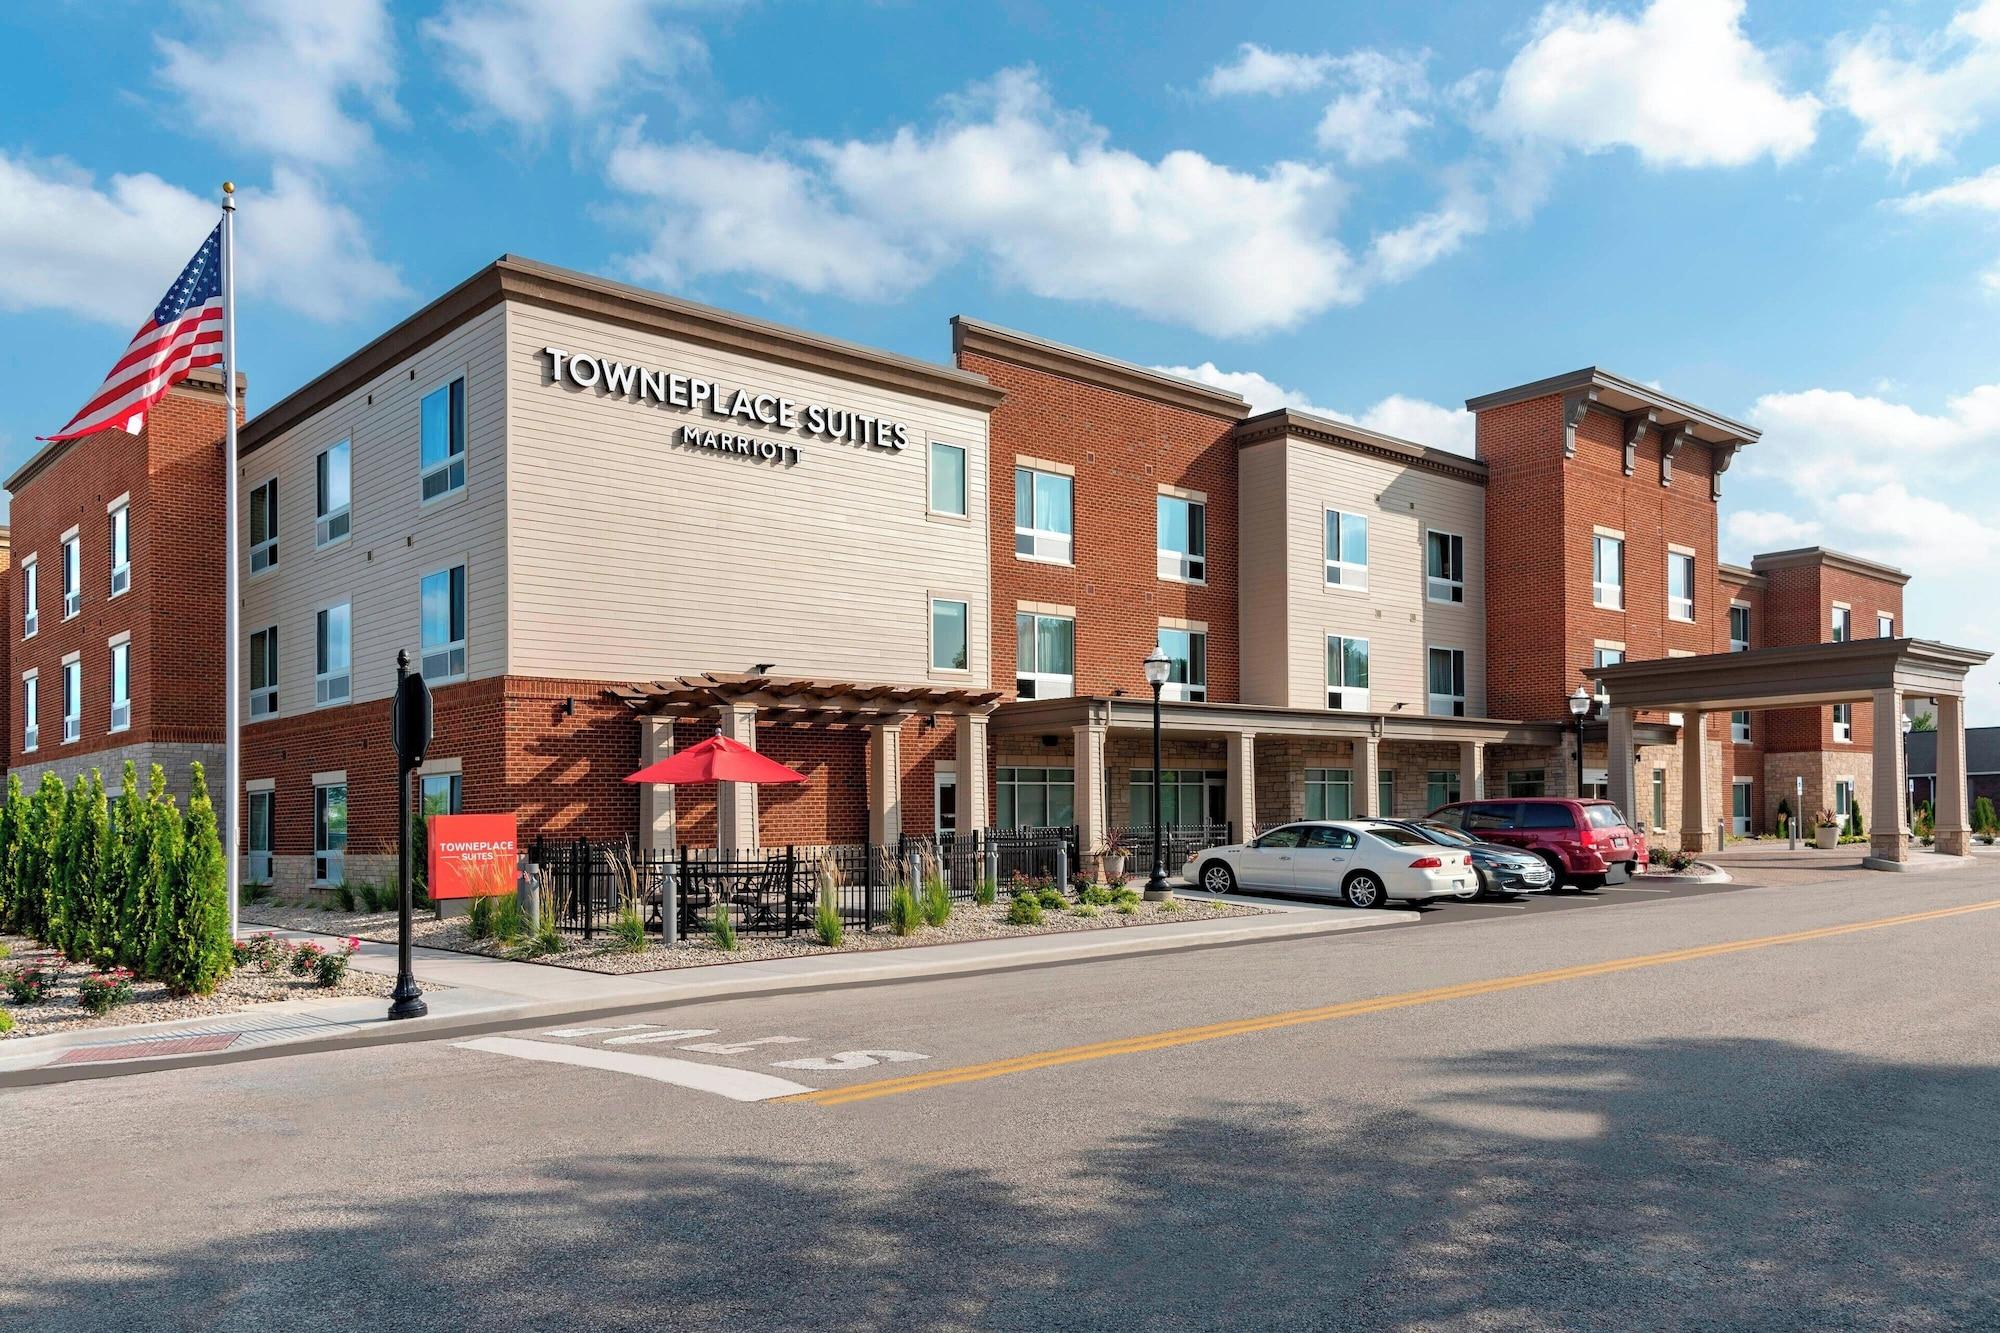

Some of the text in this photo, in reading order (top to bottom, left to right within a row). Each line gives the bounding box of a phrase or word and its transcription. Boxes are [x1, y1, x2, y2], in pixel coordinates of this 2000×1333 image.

[545, 347, 911, 451] TOWNEPLACE SUITES
[682, 425, 804, 465] MARRIOTT
[440, 841, 513, 852] TOWNEPLACE
[461, 852, 494, 861] SUITES
